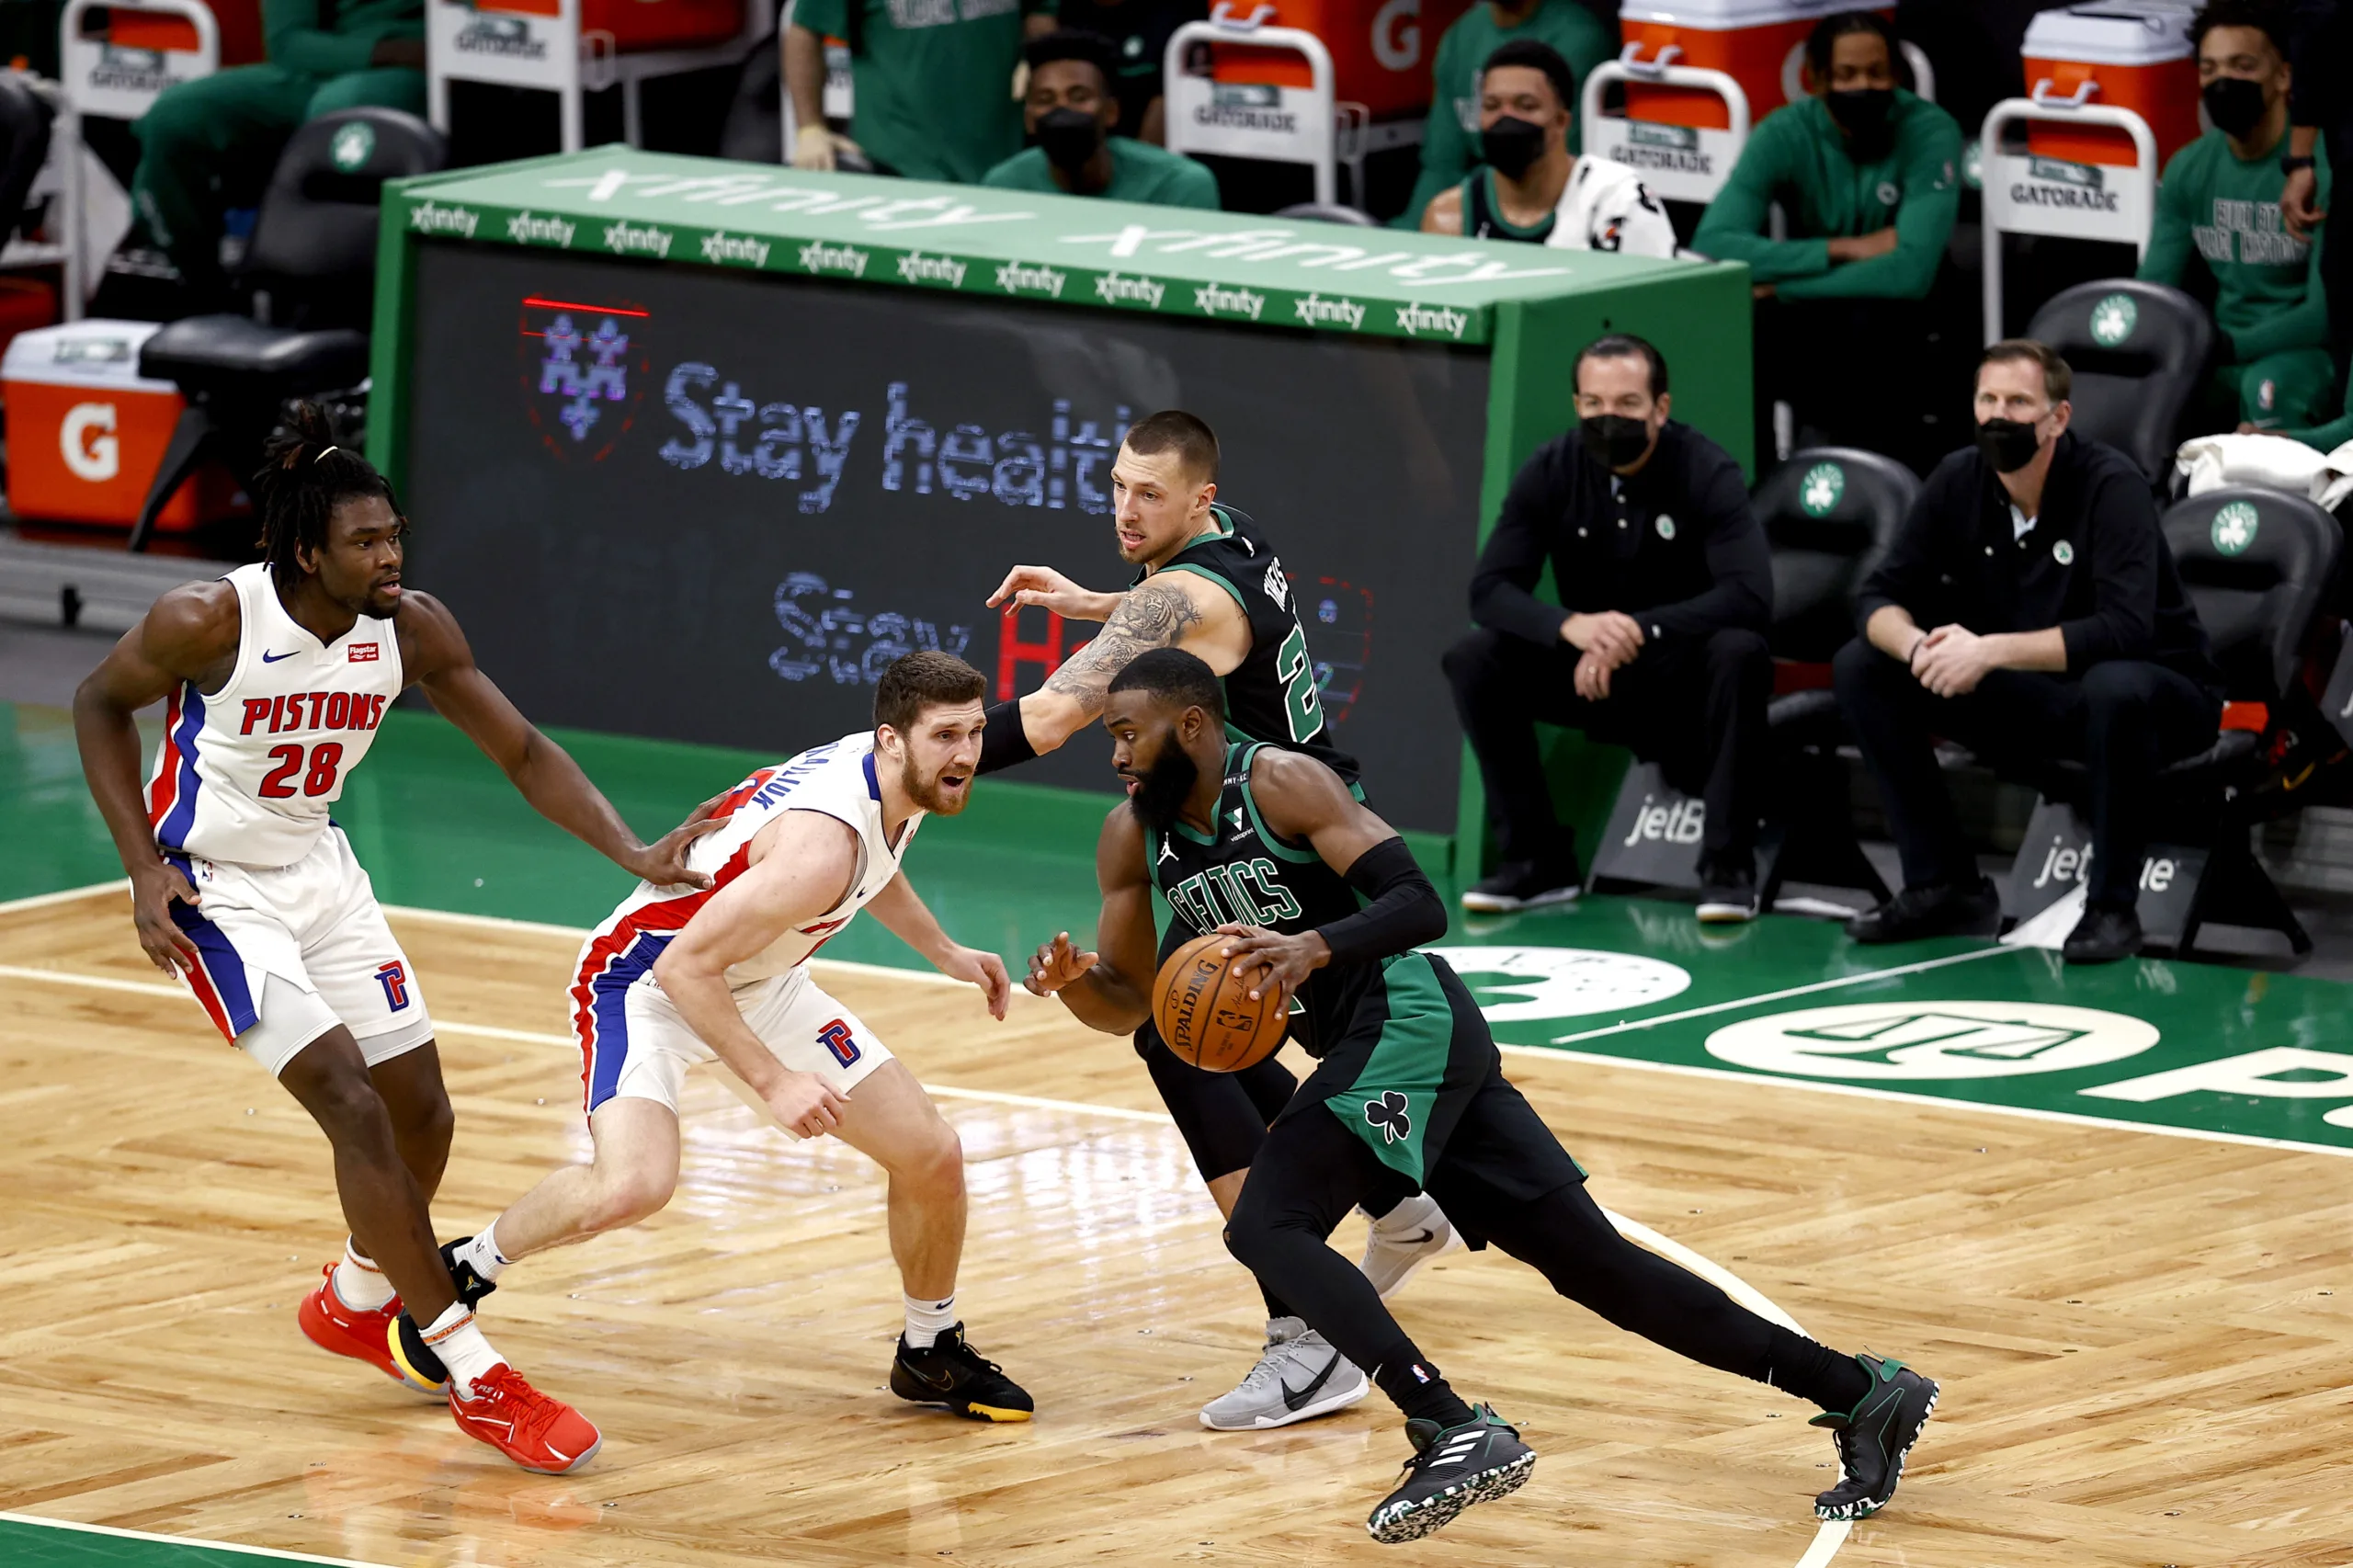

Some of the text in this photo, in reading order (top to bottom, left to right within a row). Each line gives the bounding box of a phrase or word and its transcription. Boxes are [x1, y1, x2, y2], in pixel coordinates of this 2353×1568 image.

[1371, 0, 1422, 71] G
[543, 169, 1038, 231] xfinity
[2010, 184, 2119, 212] GATORADE
[411, 200, 1468, 339] xfinity xfinity xfinity xfinity xfinity xfinity xfinity xfinity xfinity xfinity xfinity
[1057, 223, 1573, 287] xfinity
[60, 402, 119, 482] G
[658, 361, 860, 514] Stay
[349, 645, 377, 654] Flagstar
[239, 691, 387, 735] PISTONS
[1276, 622, 1324, 744] 2
[257, 742, 344, 799] 28
[1230, 827, 1255, 843] vistaprint
[1624, 793, 1706, 846] jetB
[1166, 858, 1303, 937] CELTICS
[1174, 959, 1220, 1052] SPALDING
